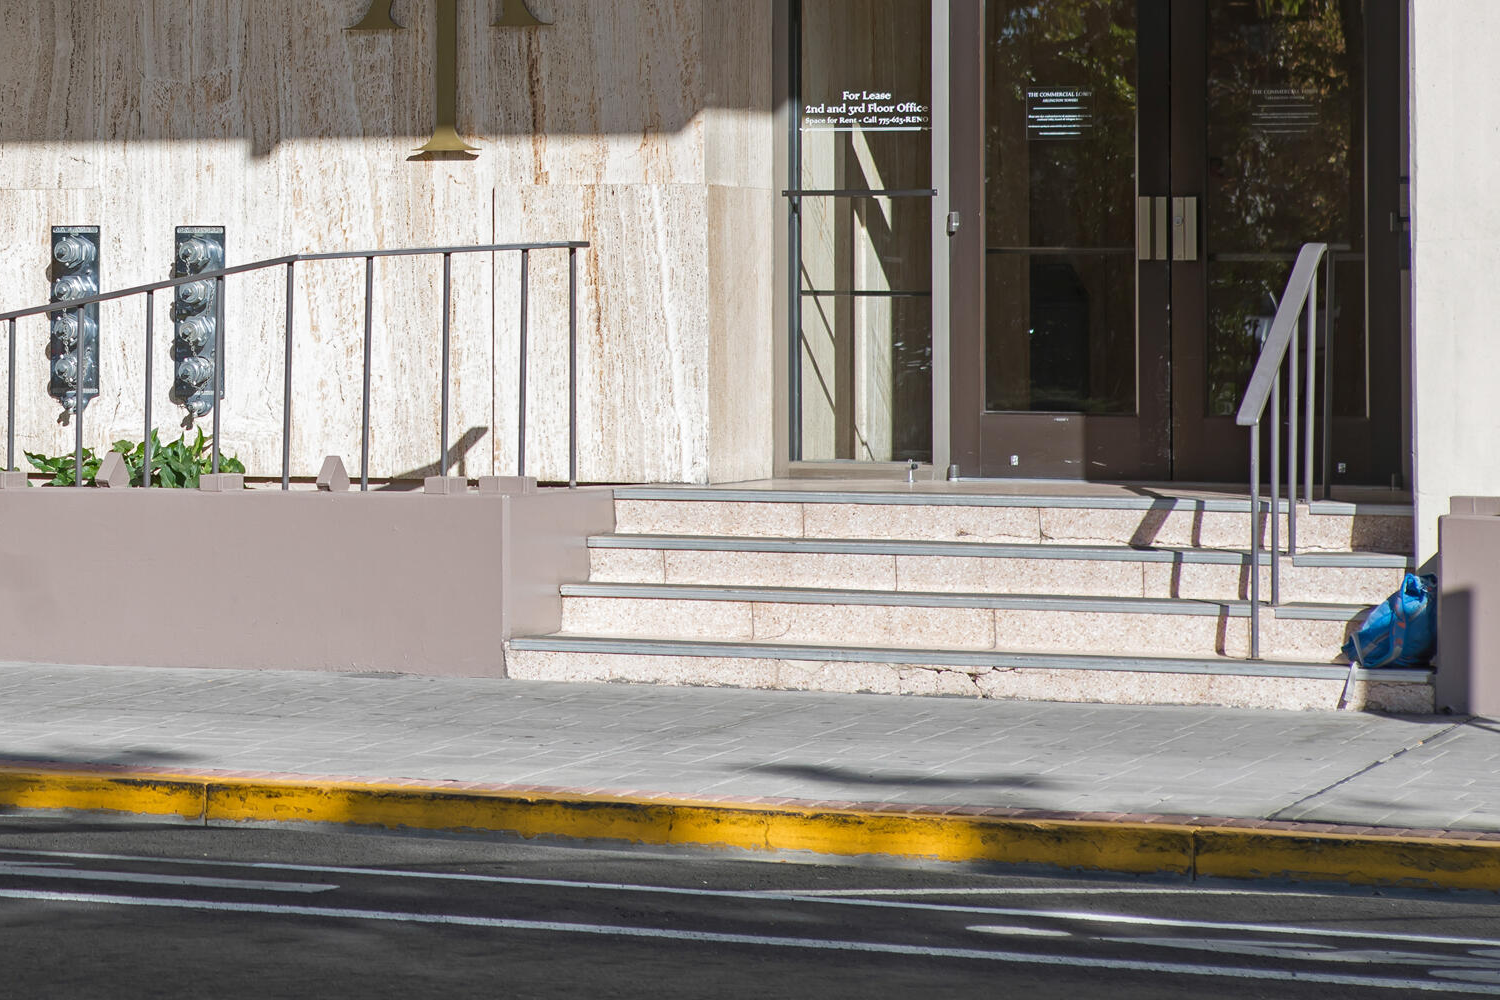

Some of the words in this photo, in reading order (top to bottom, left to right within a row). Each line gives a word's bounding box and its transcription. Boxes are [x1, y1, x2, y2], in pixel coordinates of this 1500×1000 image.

[842, 91, 860, 100] For
[863, 91, 891, 100] Lease
[805, 103, 825, 113] 2nd
[826, 103, 846, 113] and
[848, 103, 865, 115] 3rd
[868, 102, 895, 113] Floor
[896, 102, 929, 112] Office
[805, 117, 826, 125] Space
[827, 116, 837, 124] for
[839, 116, 857, 124] Rent
